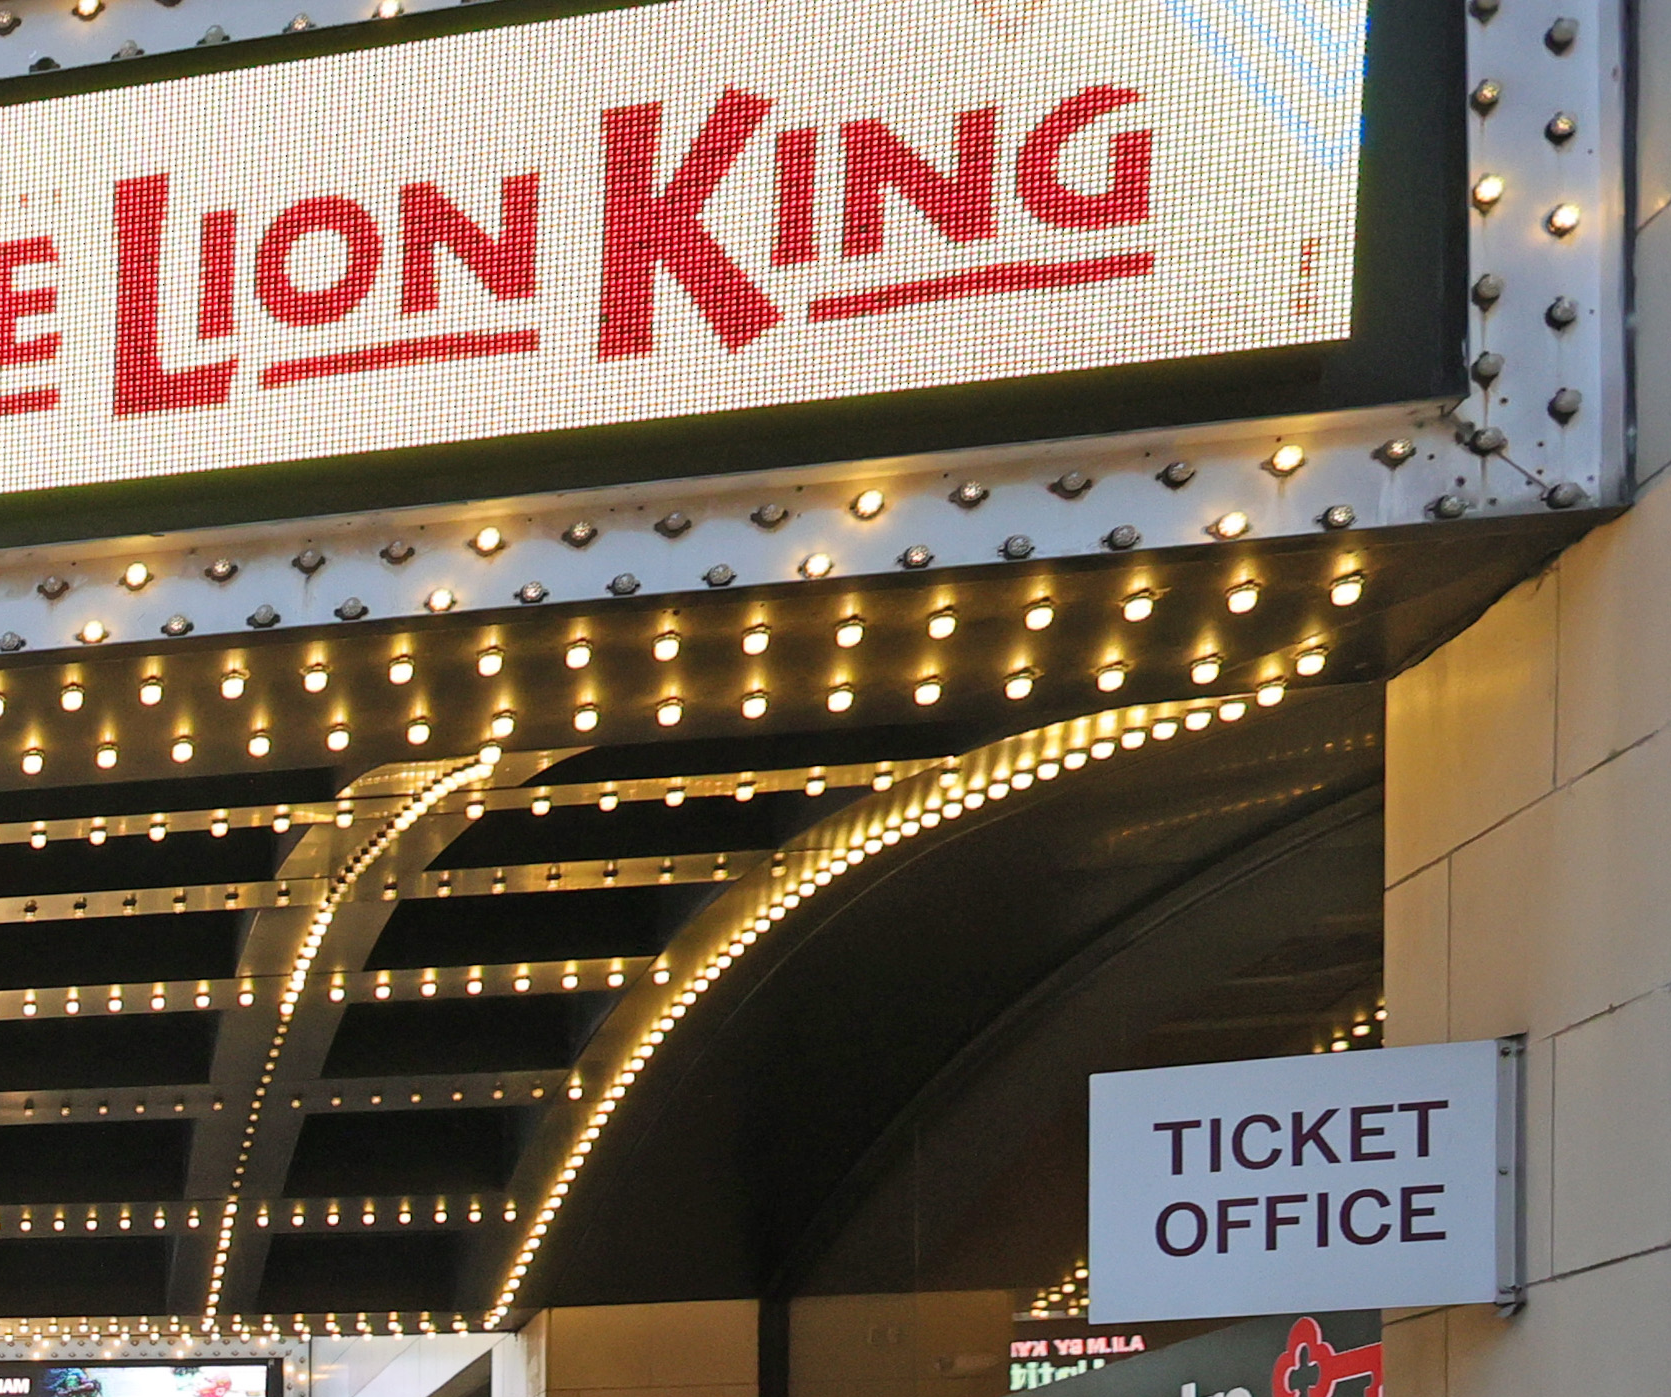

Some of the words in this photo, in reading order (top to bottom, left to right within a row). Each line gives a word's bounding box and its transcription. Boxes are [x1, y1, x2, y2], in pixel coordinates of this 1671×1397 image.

[112, 170, 541, 420] LION
[597, 82, 1155, 366] KING
[1151, 1099, 1451, 1177] TICKET
[1153, 1183, 1449, 1258] OFFICE
